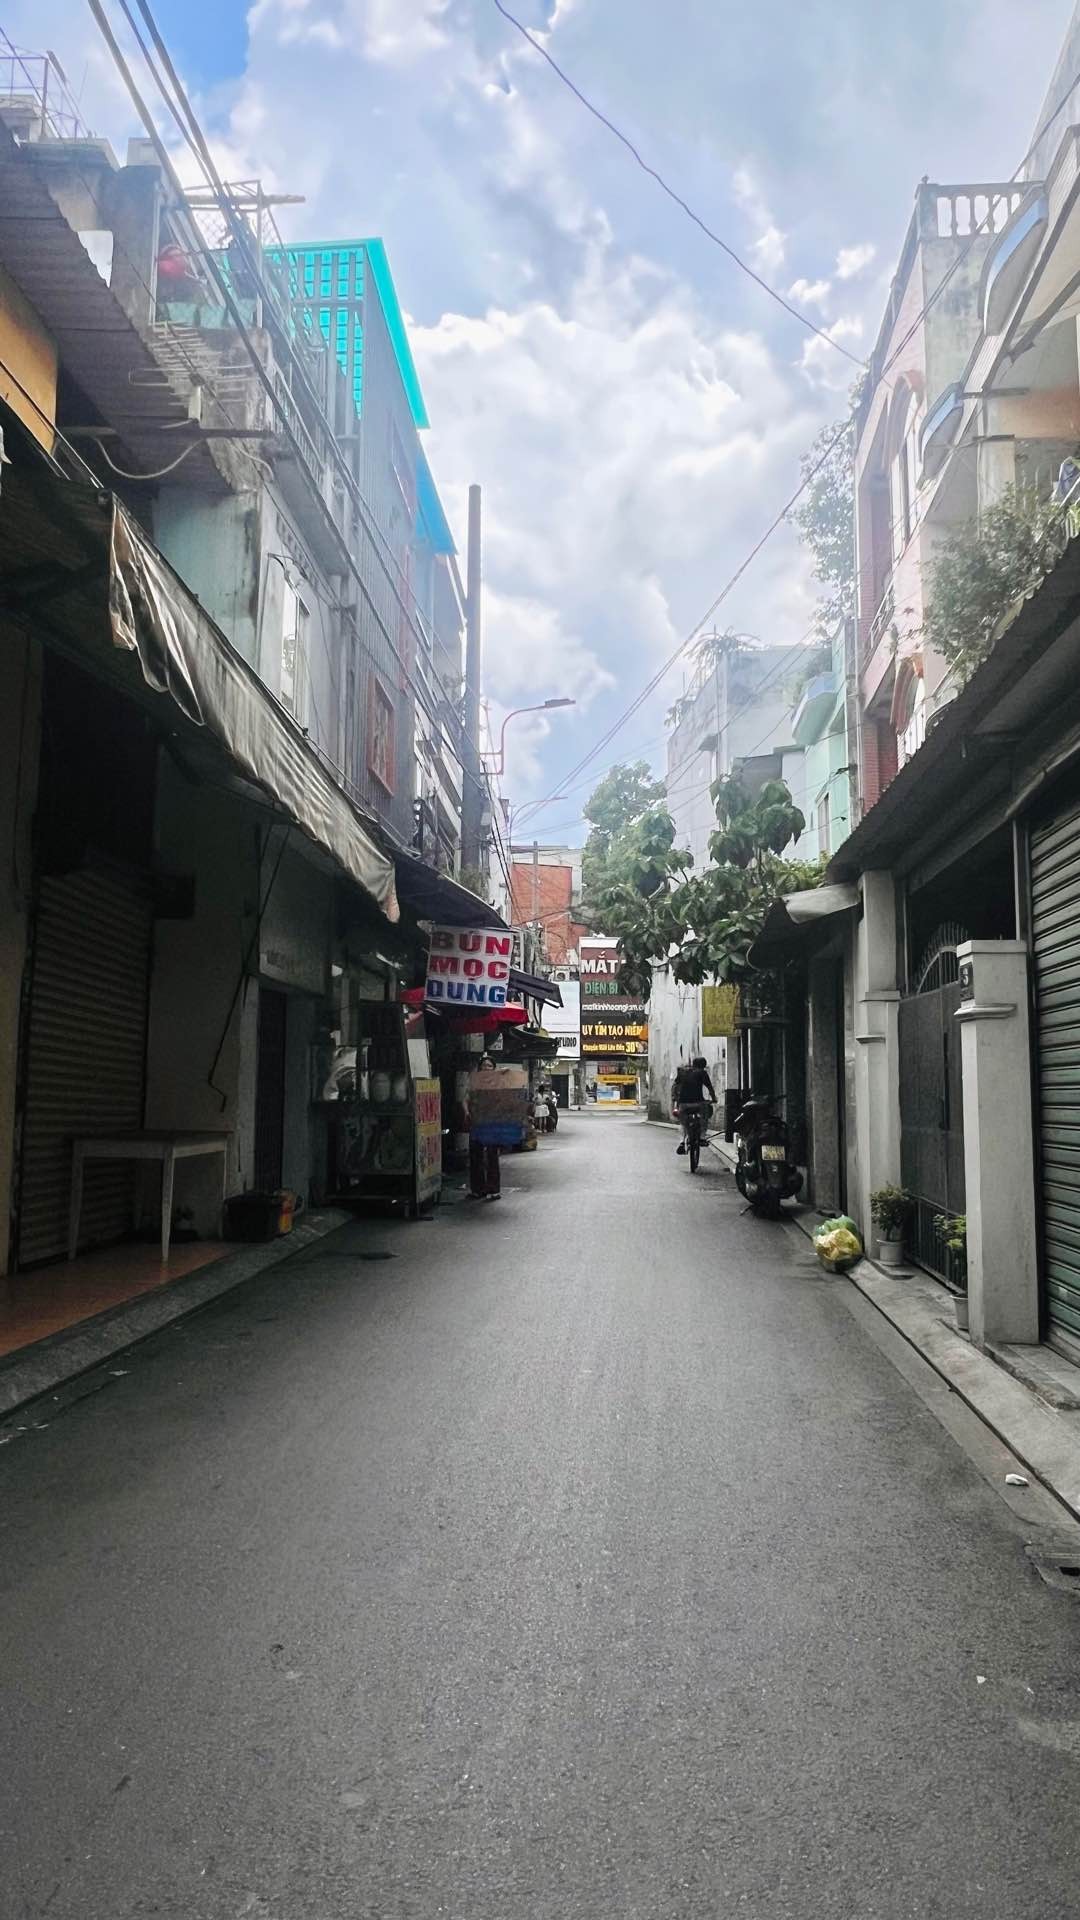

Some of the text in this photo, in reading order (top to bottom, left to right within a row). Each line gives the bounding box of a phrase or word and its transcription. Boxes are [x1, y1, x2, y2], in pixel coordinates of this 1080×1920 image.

[432, 931, 510, 955] BÚN
[430, 955, 508, 981] MỌC
[581, 951, 618, 973] MẮT
[426, 980, 506, 1003] DUNG
[582, 1024, 593, 1036] UY
